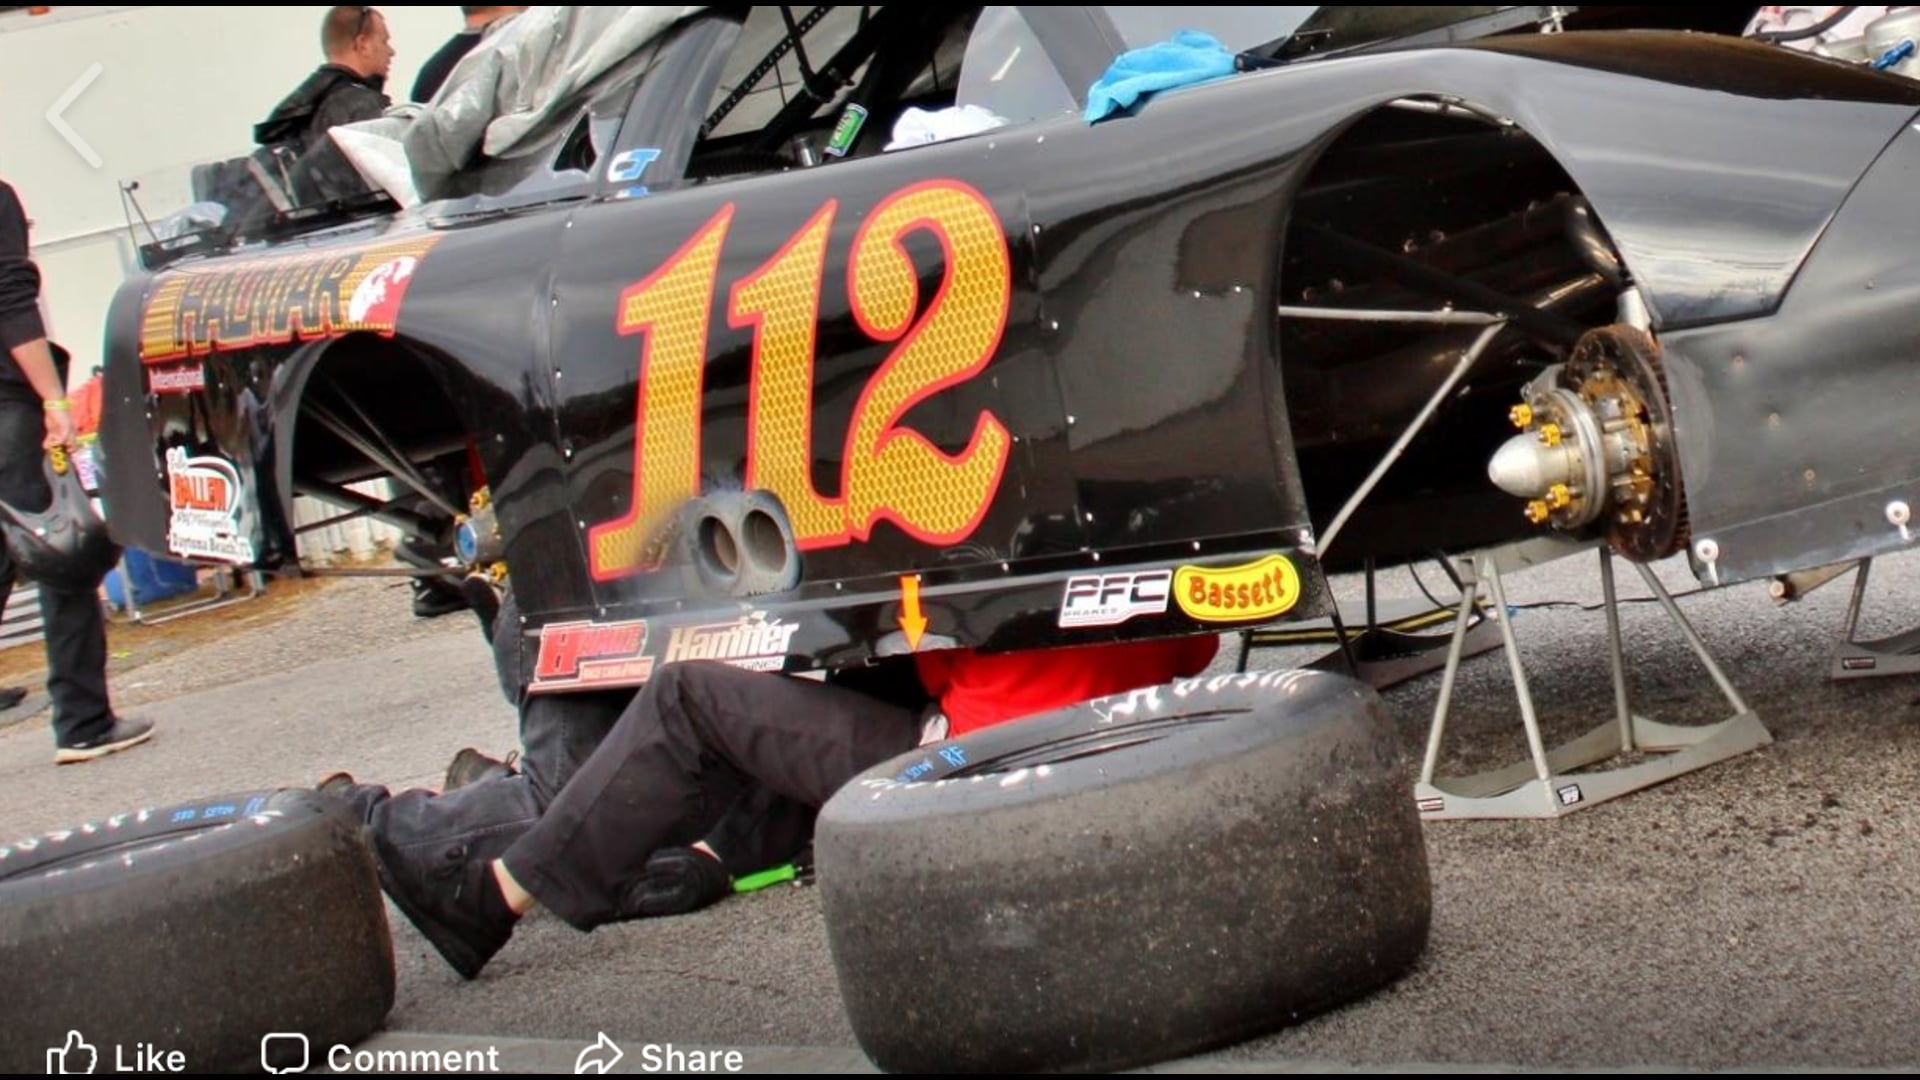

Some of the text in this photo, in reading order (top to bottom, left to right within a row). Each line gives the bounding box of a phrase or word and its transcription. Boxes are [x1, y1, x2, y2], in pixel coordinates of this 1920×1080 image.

[589, 179, 1011, 580] 112
[1065, 573, 1169, 608] PFC
[1188, 565, 1285, 610] Bassett
